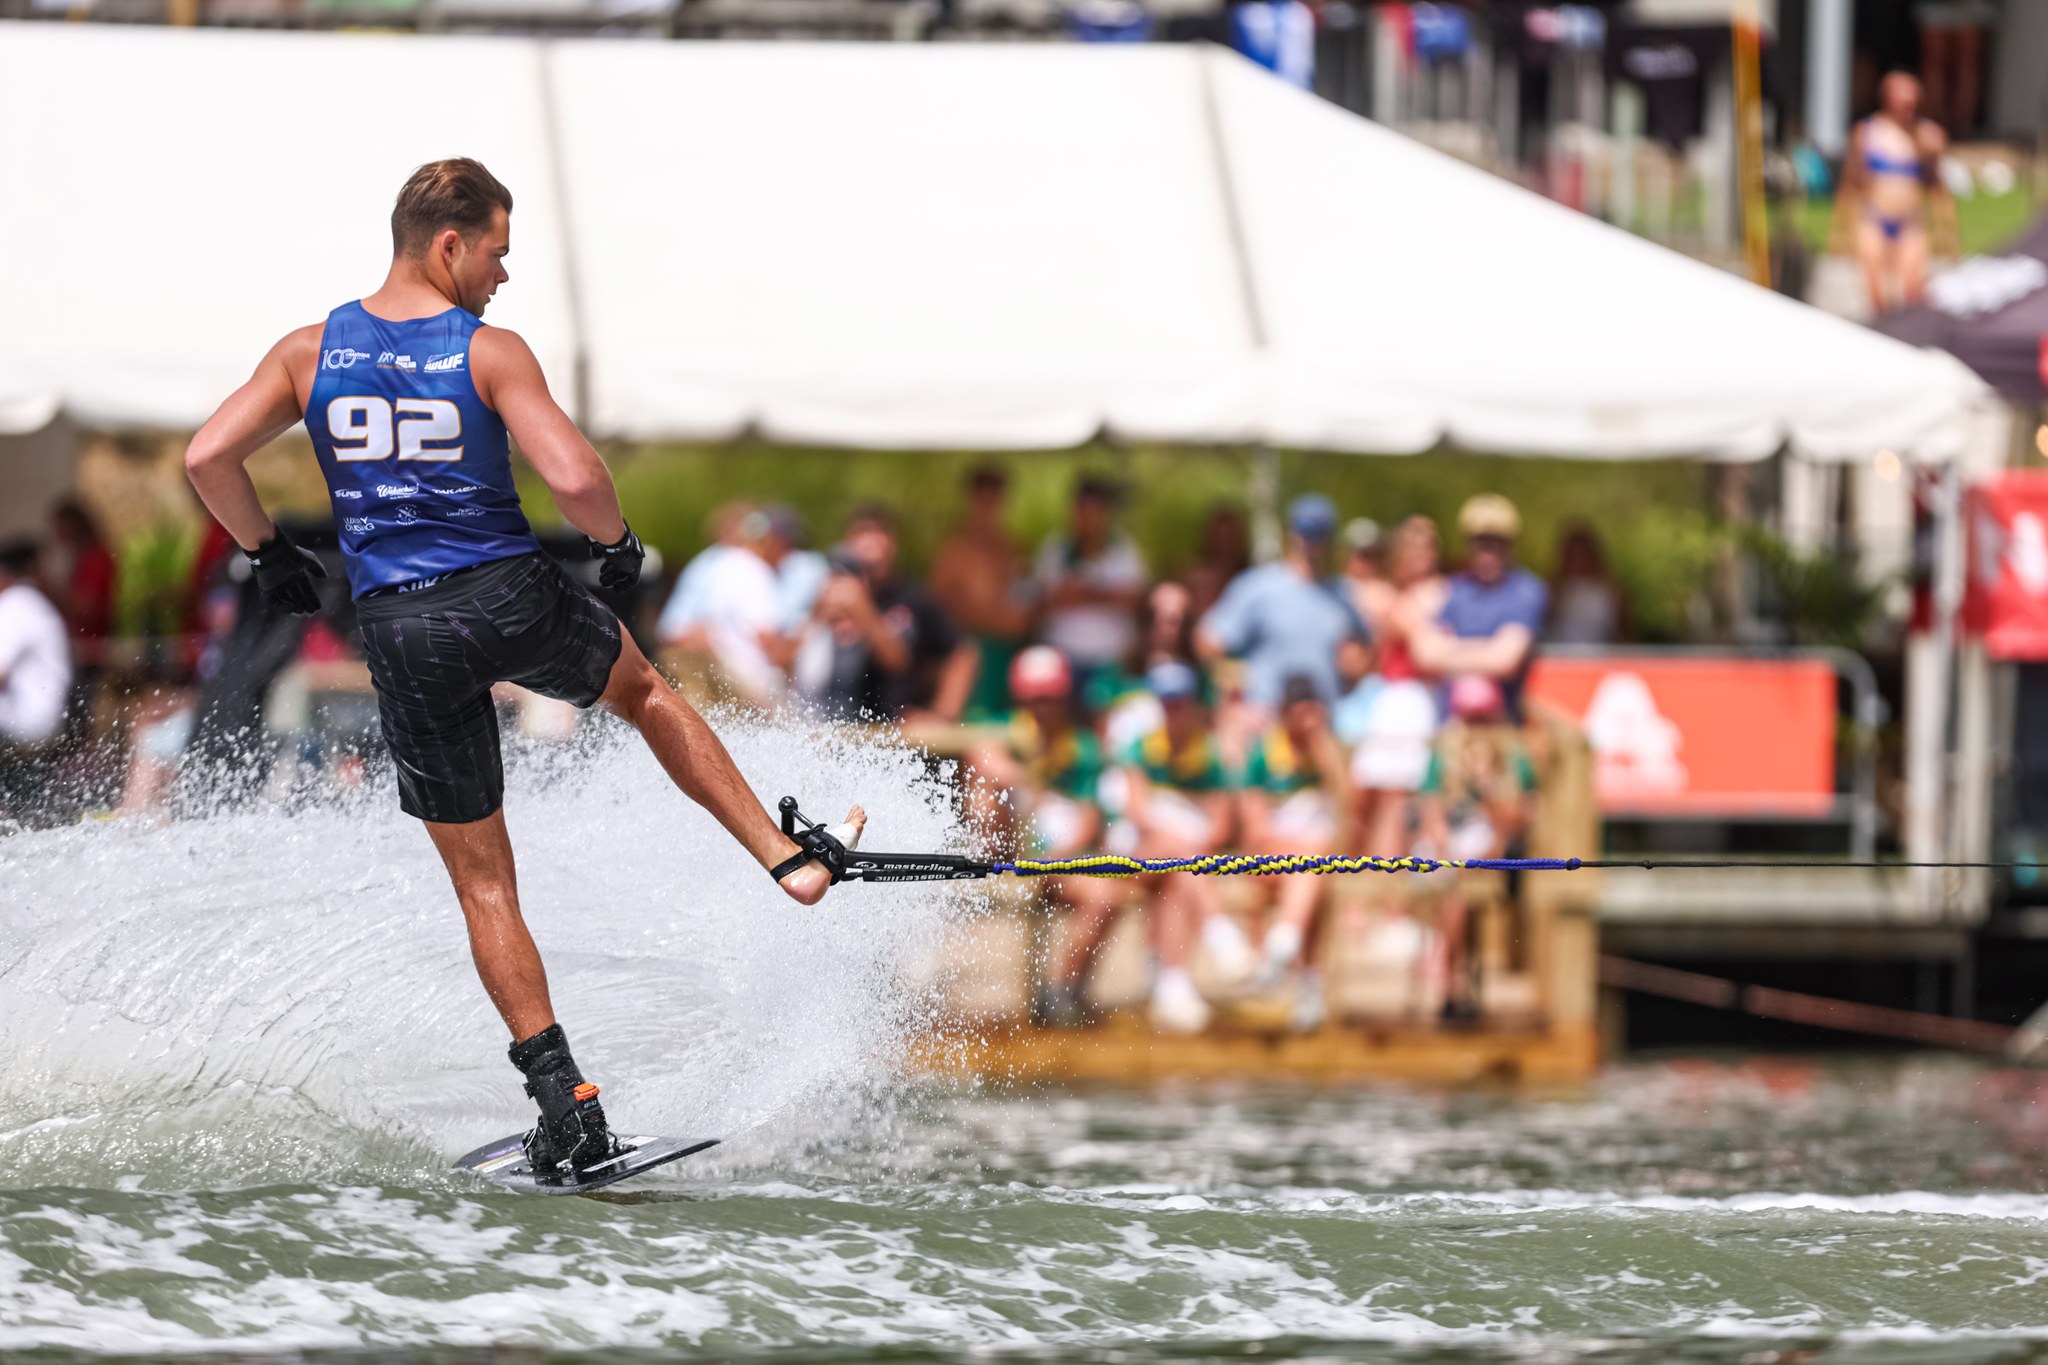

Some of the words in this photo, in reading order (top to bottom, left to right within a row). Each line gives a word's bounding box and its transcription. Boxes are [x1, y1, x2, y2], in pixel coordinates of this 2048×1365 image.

[322, 348, 356, 370] 100
[327, 395, 464, 462] 92
[883, 863, 954, 871] masterline
